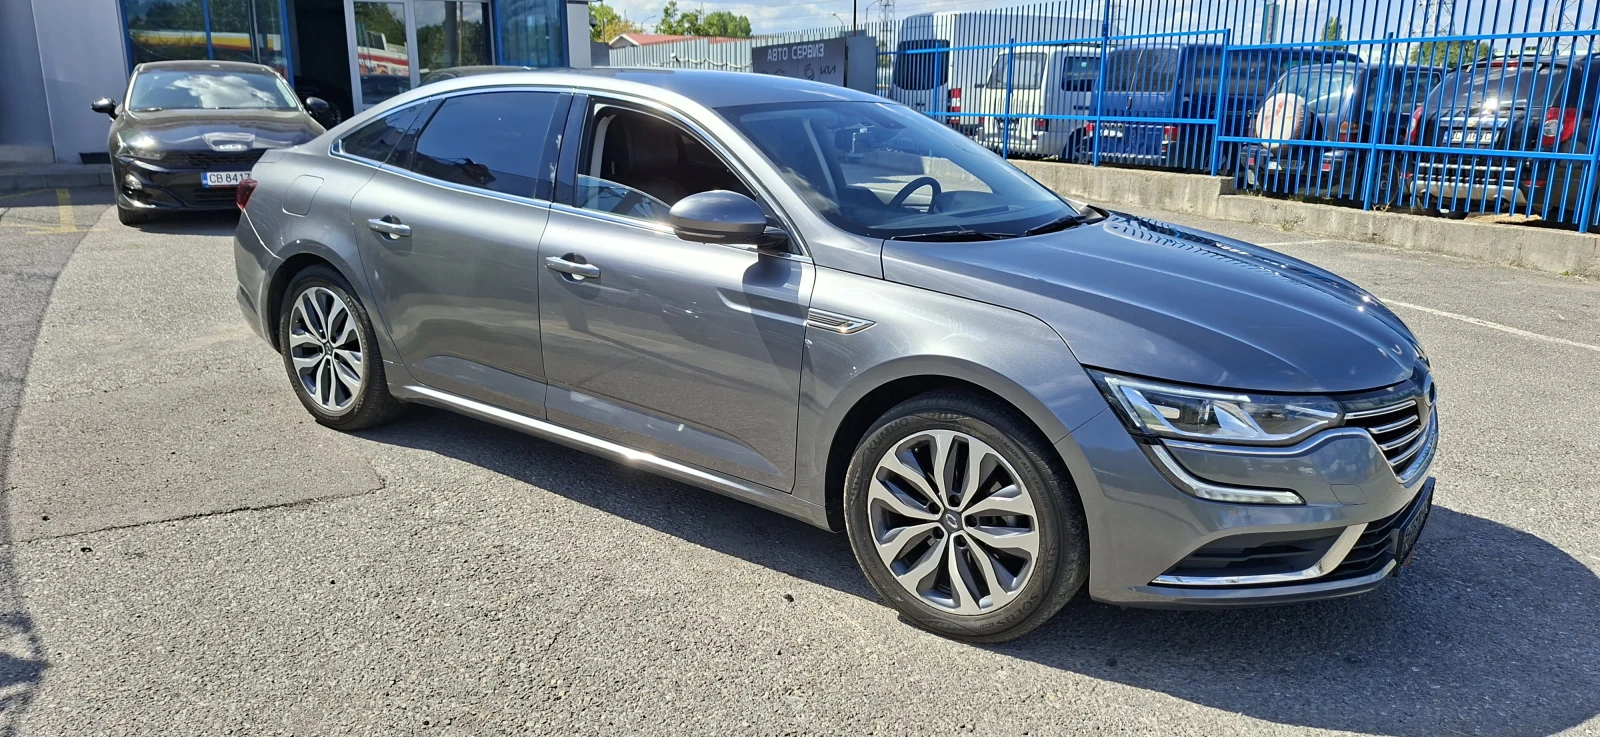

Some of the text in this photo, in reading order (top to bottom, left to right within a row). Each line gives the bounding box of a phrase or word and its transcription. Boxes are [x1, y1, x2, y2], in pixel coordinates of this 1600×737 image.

[767, 43, 824, 61] АВТО СЕРВИЗ
[866, 418, 908, 453] KUMHO
[996, 592, 1040, 628] SOLUS
